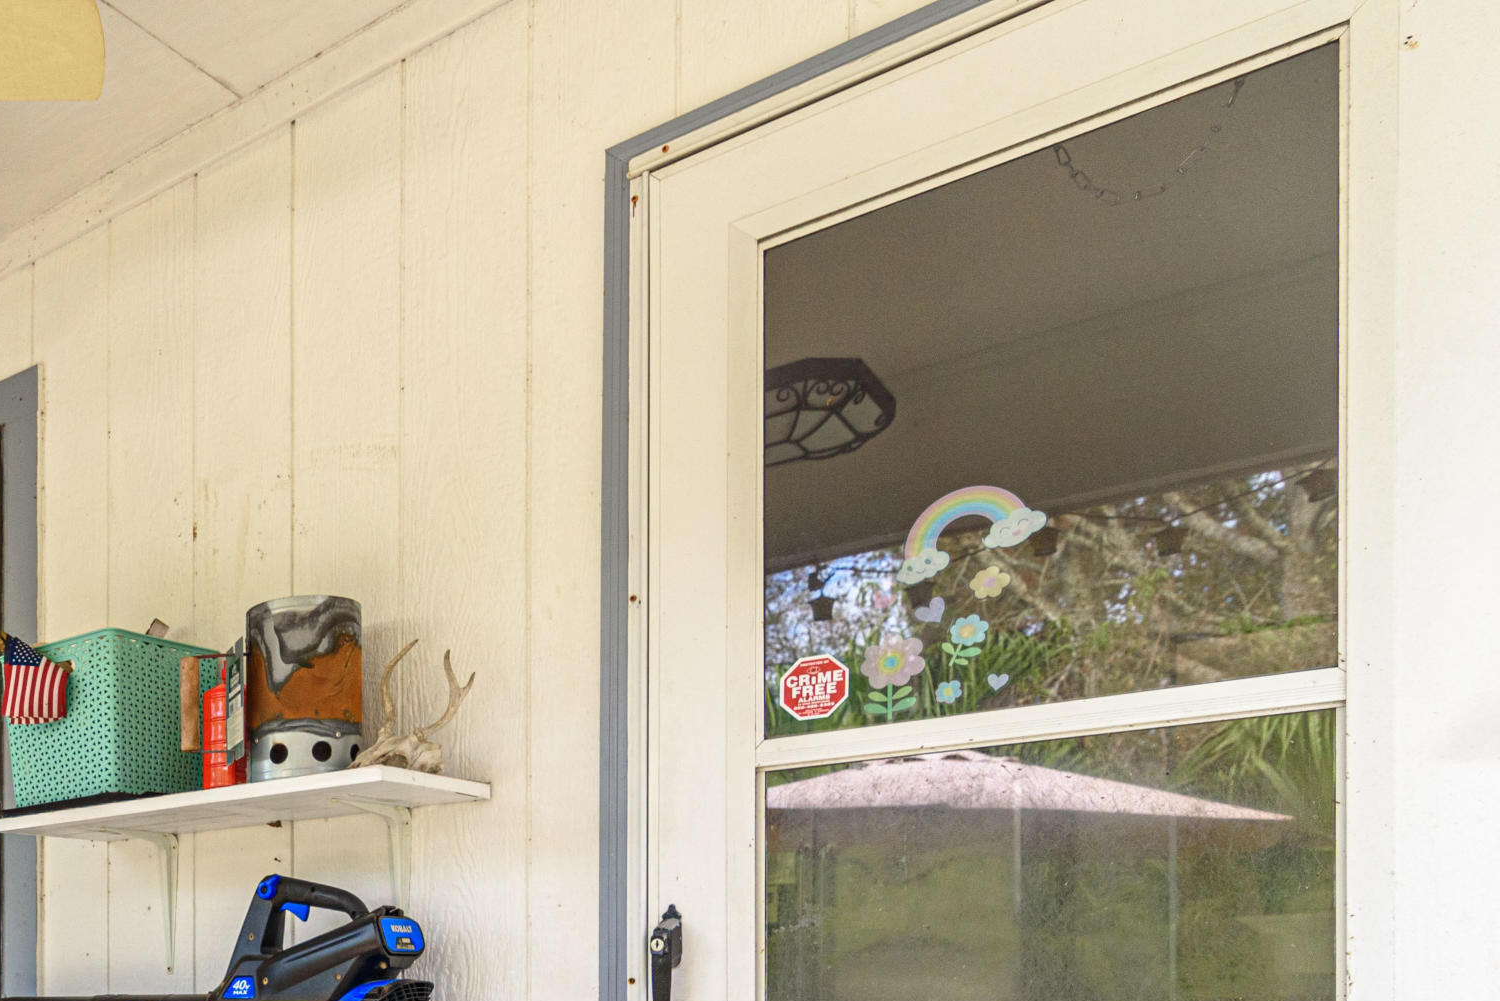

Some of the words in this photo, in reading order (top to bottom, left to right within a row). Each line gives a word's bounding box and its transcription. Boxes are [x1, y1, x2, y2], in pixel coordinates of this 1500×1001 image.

[792, 682, 837, 699] FREE
[798, 693, 831, 703] ALARMS
[390, 924, 413, 933] KOBALT
